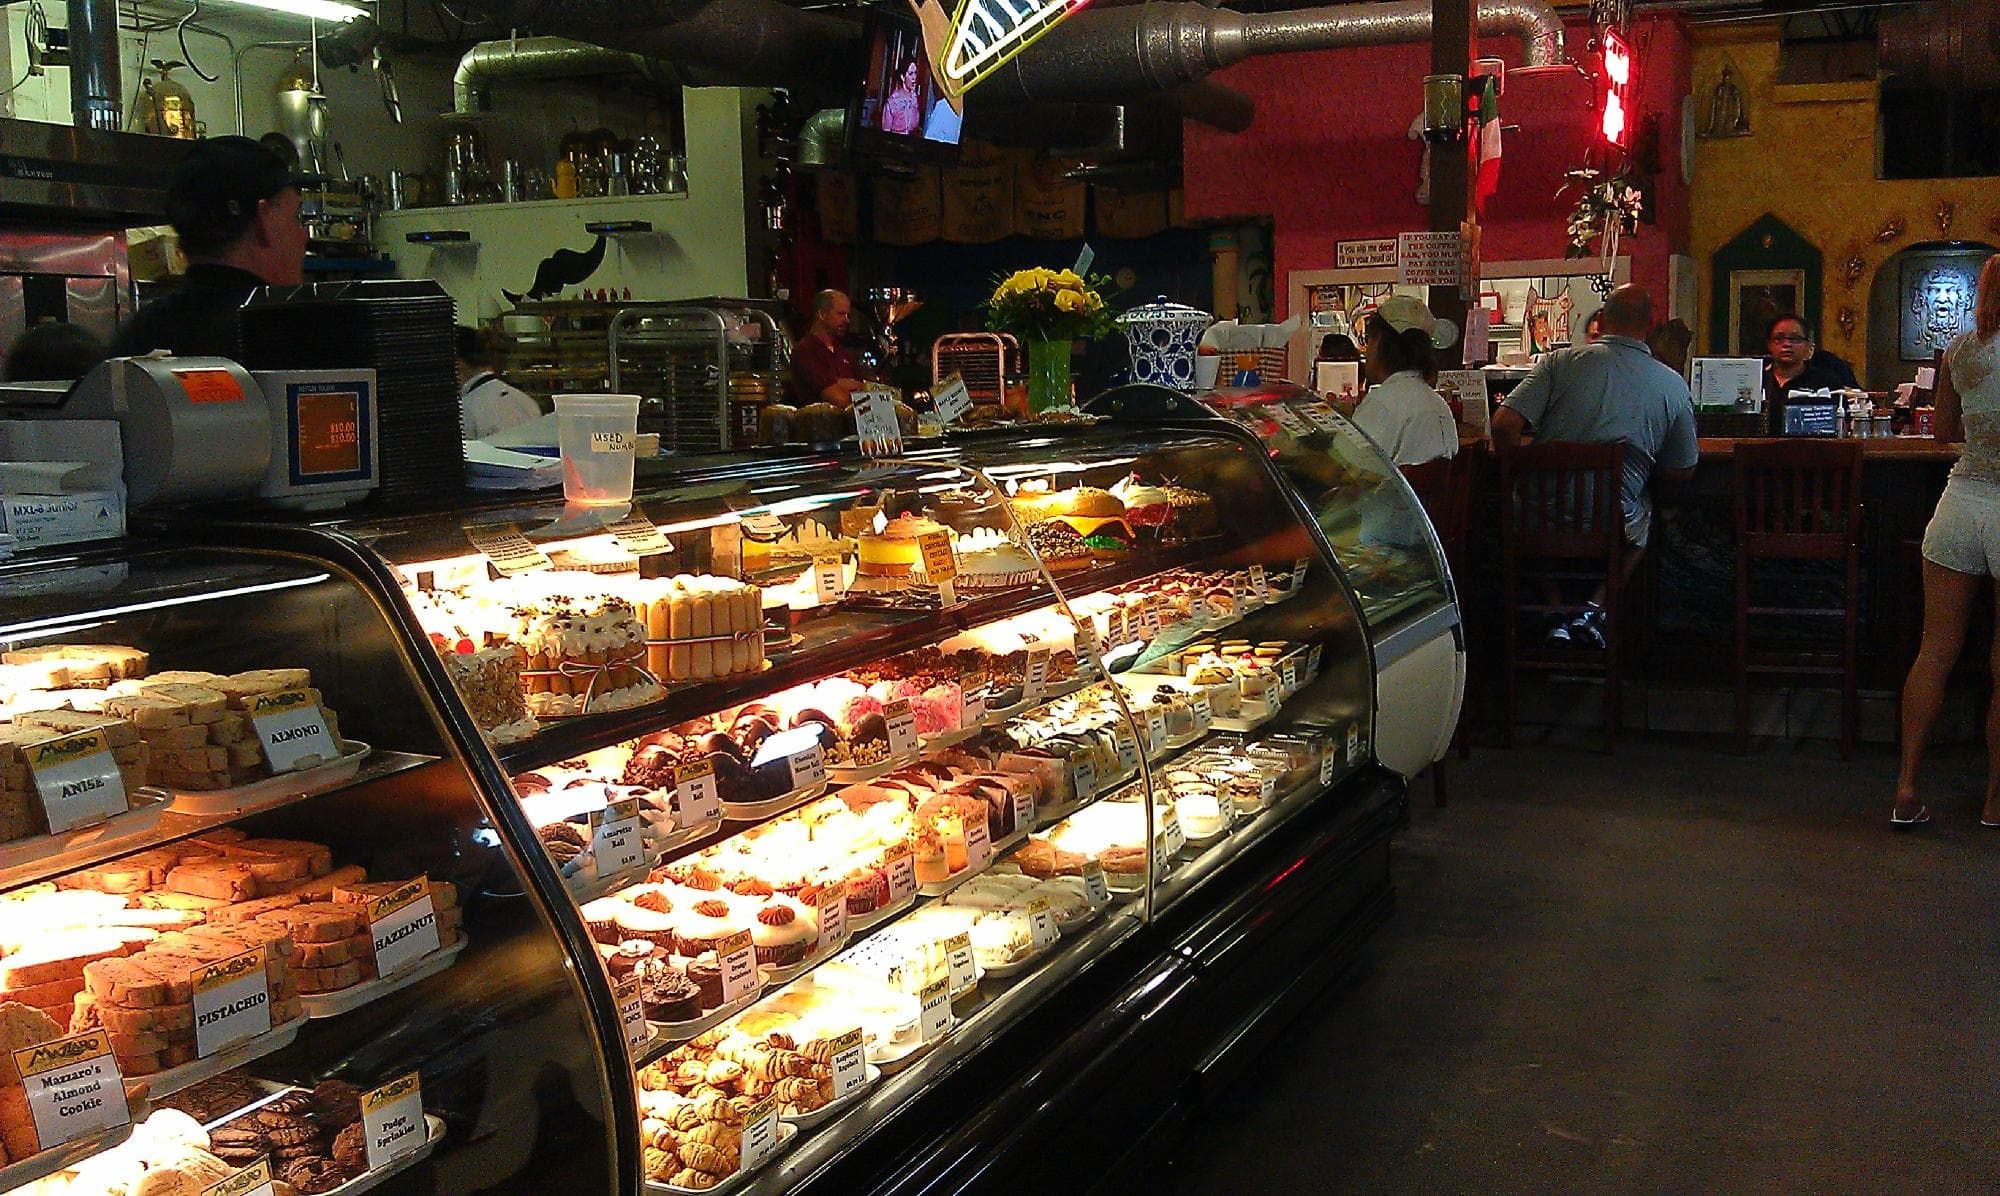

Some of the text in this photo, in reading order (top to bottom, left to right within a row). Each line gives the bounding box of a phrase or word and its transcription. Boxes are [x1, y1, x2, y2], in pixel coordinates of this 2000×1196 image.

[1408, 242, 1424, 250] THE
[593, 432, 623, 444] USED
[271, 724, 320, 744] ALMOND
[62, 778, 105, 799] ANISE
[602, 826, 633, 840] Amaretto
[612, 838, 626, 849] Ball
[375, 912, 434, 953] HAZELNUT
[198, 992, 267, 1027] PISTACHIO
[41, 1064, 102, 1089] Mazzaro's
[52, 1080, 102, 1103] Almond
[59, 1097, 103, 1117] Cookie
[381, 1115, 407, 1133] Fudge
[376, 1124, 415, 1148] Sprinkles
